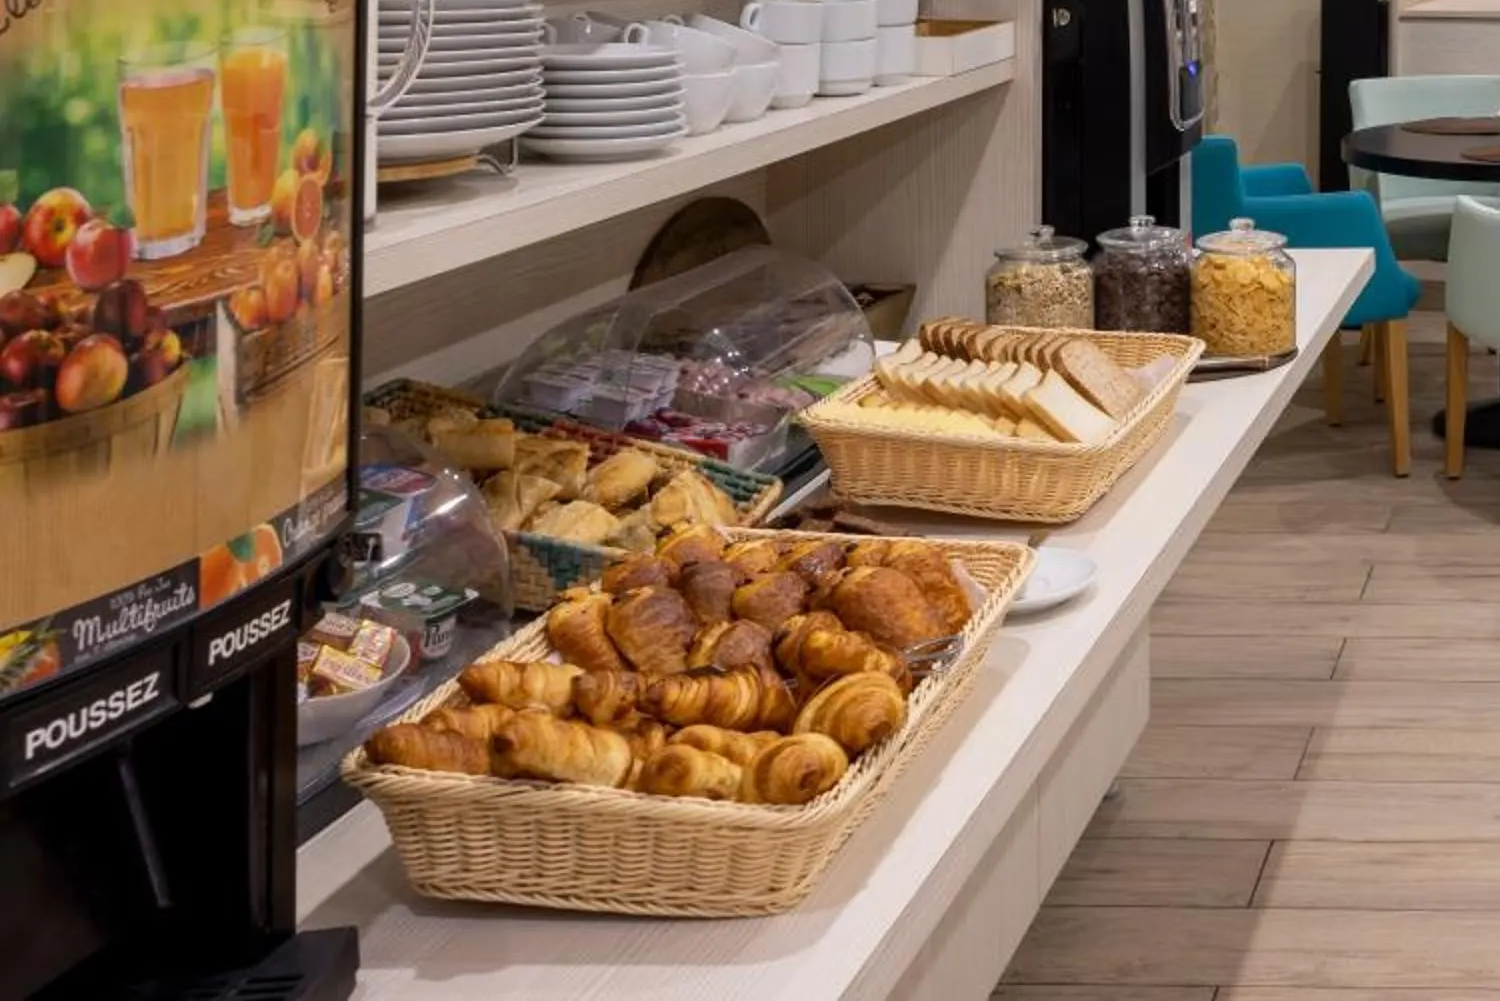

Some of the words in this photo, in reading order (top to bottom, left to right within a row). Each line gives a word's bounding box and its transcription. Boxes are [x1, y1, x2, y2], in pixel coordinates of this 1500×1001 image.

[72, 581, 196, 651] Multifruits
[207, 599, 292, 666] POUSSEZ
[25, 671, 161, 760] POUSSEZ
